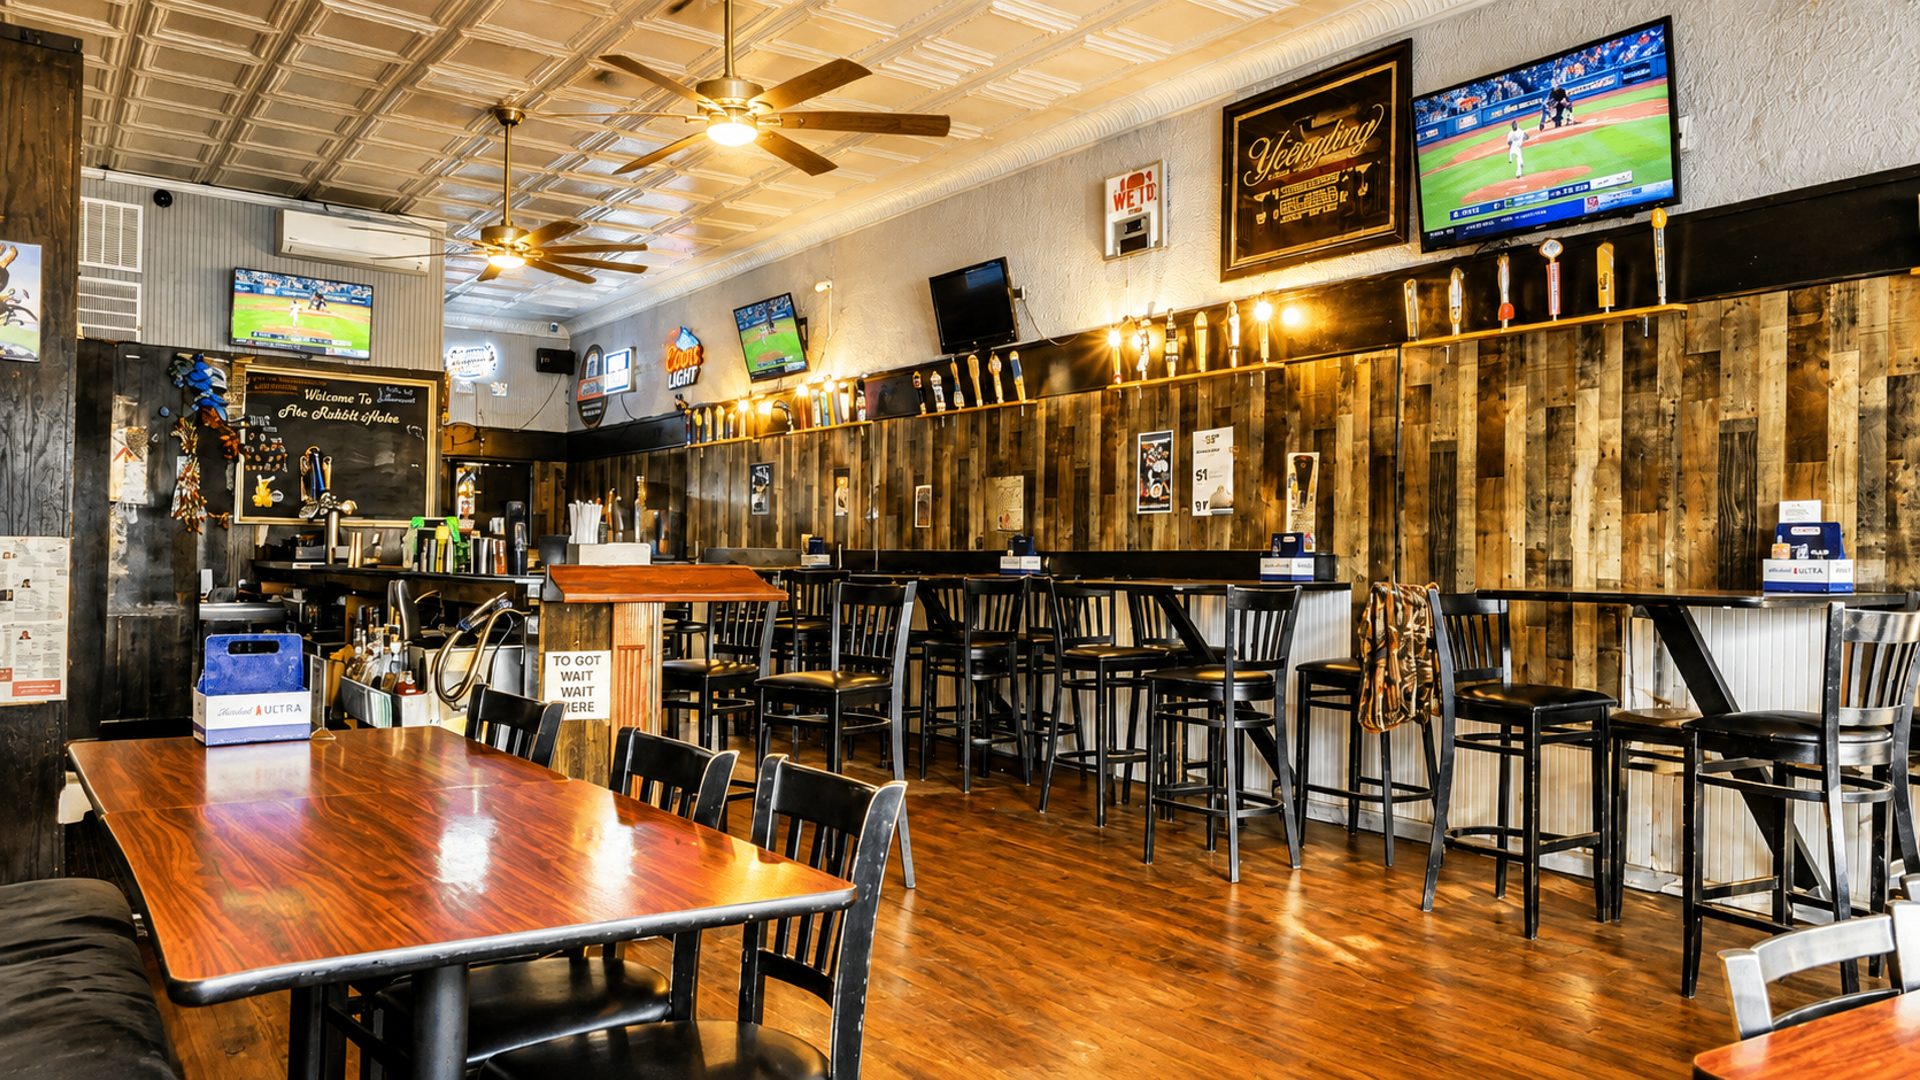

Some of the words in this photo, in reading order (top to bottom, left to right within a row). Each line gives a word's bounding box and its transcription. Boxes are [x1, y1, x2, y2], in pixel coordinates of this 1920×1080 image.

[668, 366, 698, 389] LIGHT
[358, 392, 372, 405] To
[553, 655, 571, 666] TO
[575, 655, 601, 666] GOT
[560, 671, 593, 682] WAIT
[560, 686, 595, 698] WAIT
